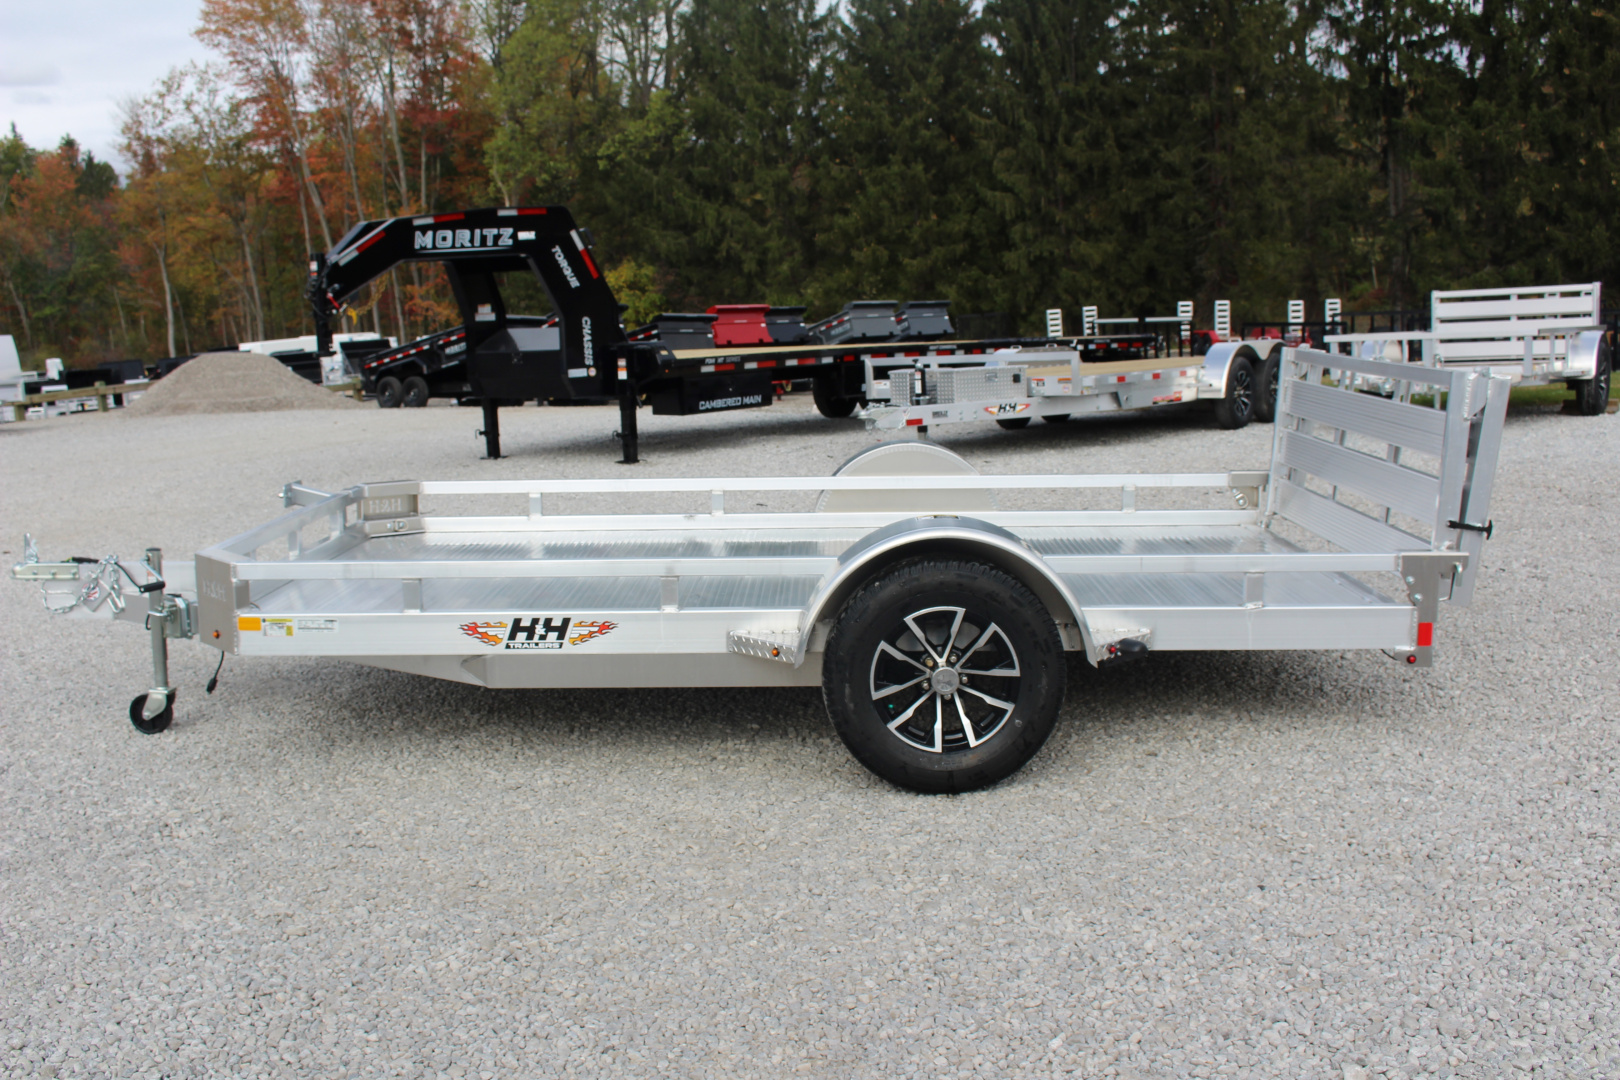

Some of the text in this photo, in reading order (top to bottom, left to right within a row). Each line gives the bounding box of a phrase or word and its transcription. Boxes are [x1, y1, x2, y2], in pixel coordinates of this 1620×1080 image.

[414, 227, 514, 250] MORITZ
[551, 245, 580, 288] TORQUE
[581, 316, 594, 366] CHASSIS
[699, 394, 762, 410] CAMBERED MAIN
[507, 617, 571, 641] H&H
